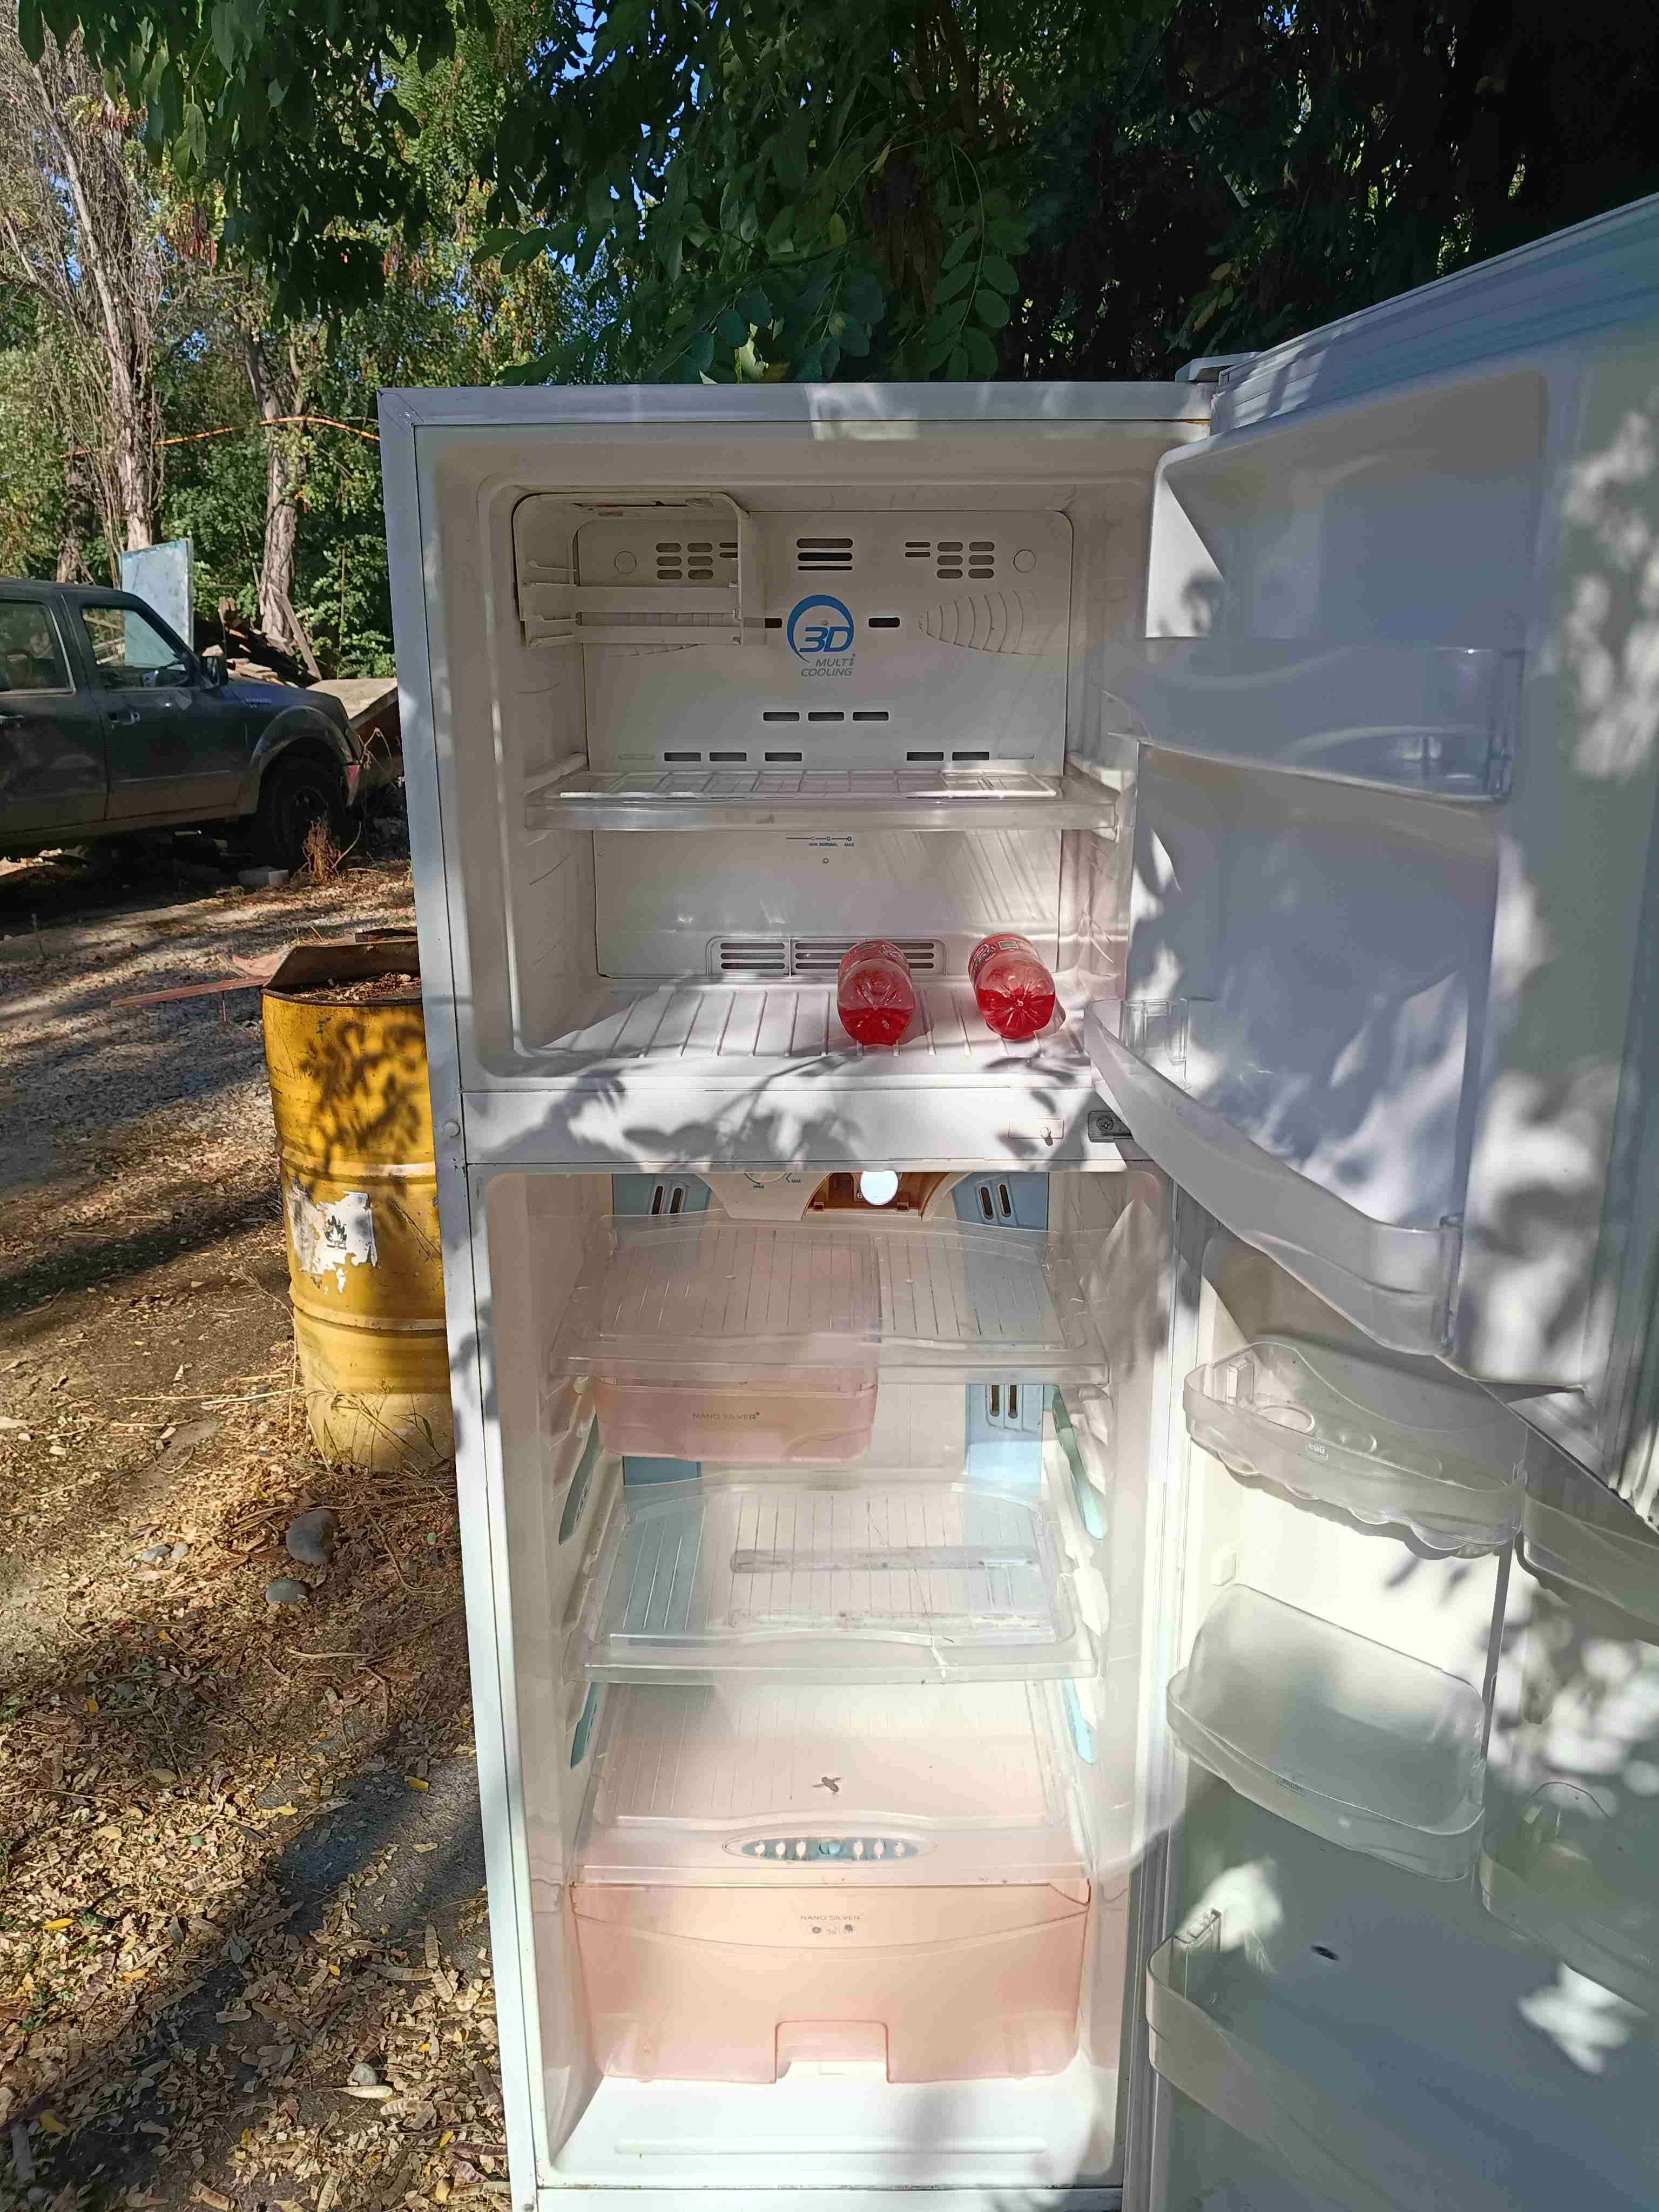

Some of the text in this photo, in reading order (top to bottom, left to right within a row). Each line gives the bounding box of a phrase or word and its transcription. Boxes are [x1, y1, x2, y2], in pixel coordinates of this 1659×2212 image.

[799, 626, 853, 652] 3D
[800, 668, 852, 677] COOLING
[1309, 1442, 1325, 1454] EGG
